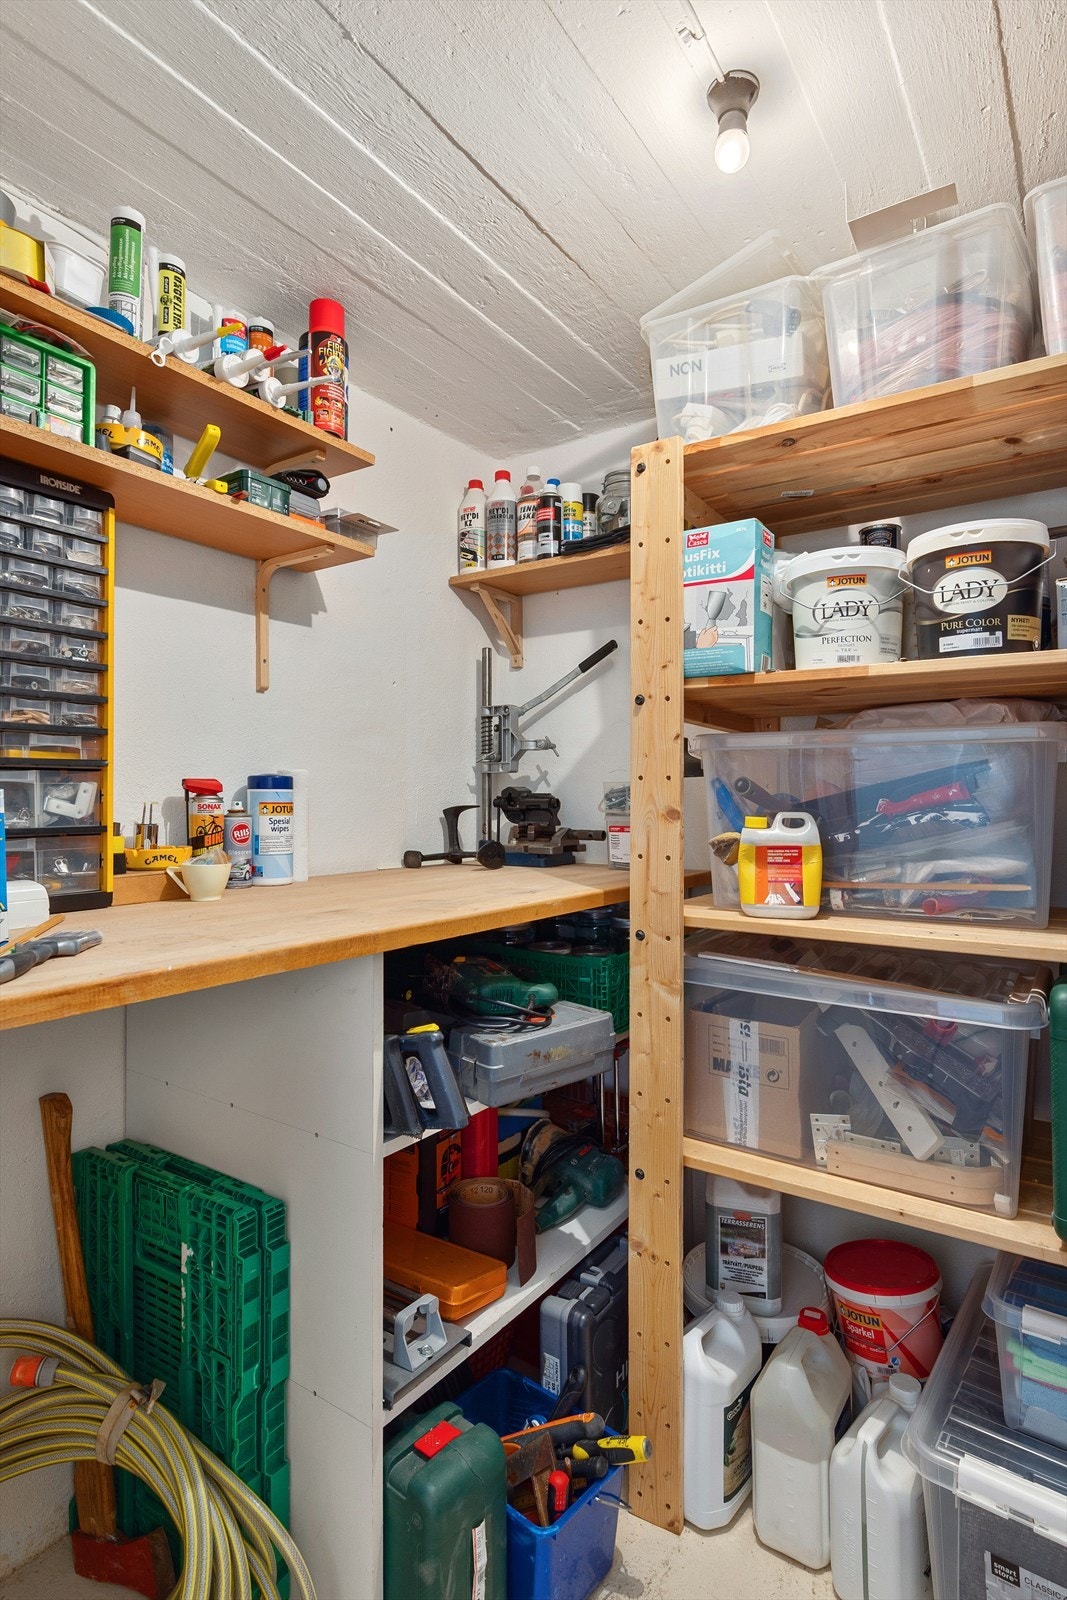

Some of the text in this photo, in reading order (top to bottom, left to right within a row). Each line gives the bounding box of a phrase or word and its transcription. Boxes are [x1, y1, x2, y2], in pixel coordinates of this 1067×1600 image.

[327, 340, 344, 352] FIRE
[96, 428, 114, 439] MEL
[40, 474, 81, 495] IRONSIDE
[688, 538, 708, 547] Casco
[684, 548, 720, 563] usFix
[956, 554, 990, 565] JOTUN
[684, 561, 726, 579] tikitti
[837, 576, 866, 585] JOTUN
[939, 578, 999, 604] LADY
[821, 599, 873, 620] LADY
[941, 617, 1002, 631] PURE COLOR
[821, 635, 872, 645] PERFECTION
[268, 817, 291, 826] Spesial
[270, 825, 290, 834] wipes
[144, 855, 179, 866] CAMEL
[480, 1186, 493, 1194] 120
[720, 1217, 765, 1230] TERRASSERENS
[846, 1308, 880, 1327] JOTUN
[845, 1320, 875, 1339] Sparkel
[993, 1562, 1017, 1577] smart
[994, 1568, 1015, 1582] store
[1024, 1577, 1061, 1599] CLASSIC
